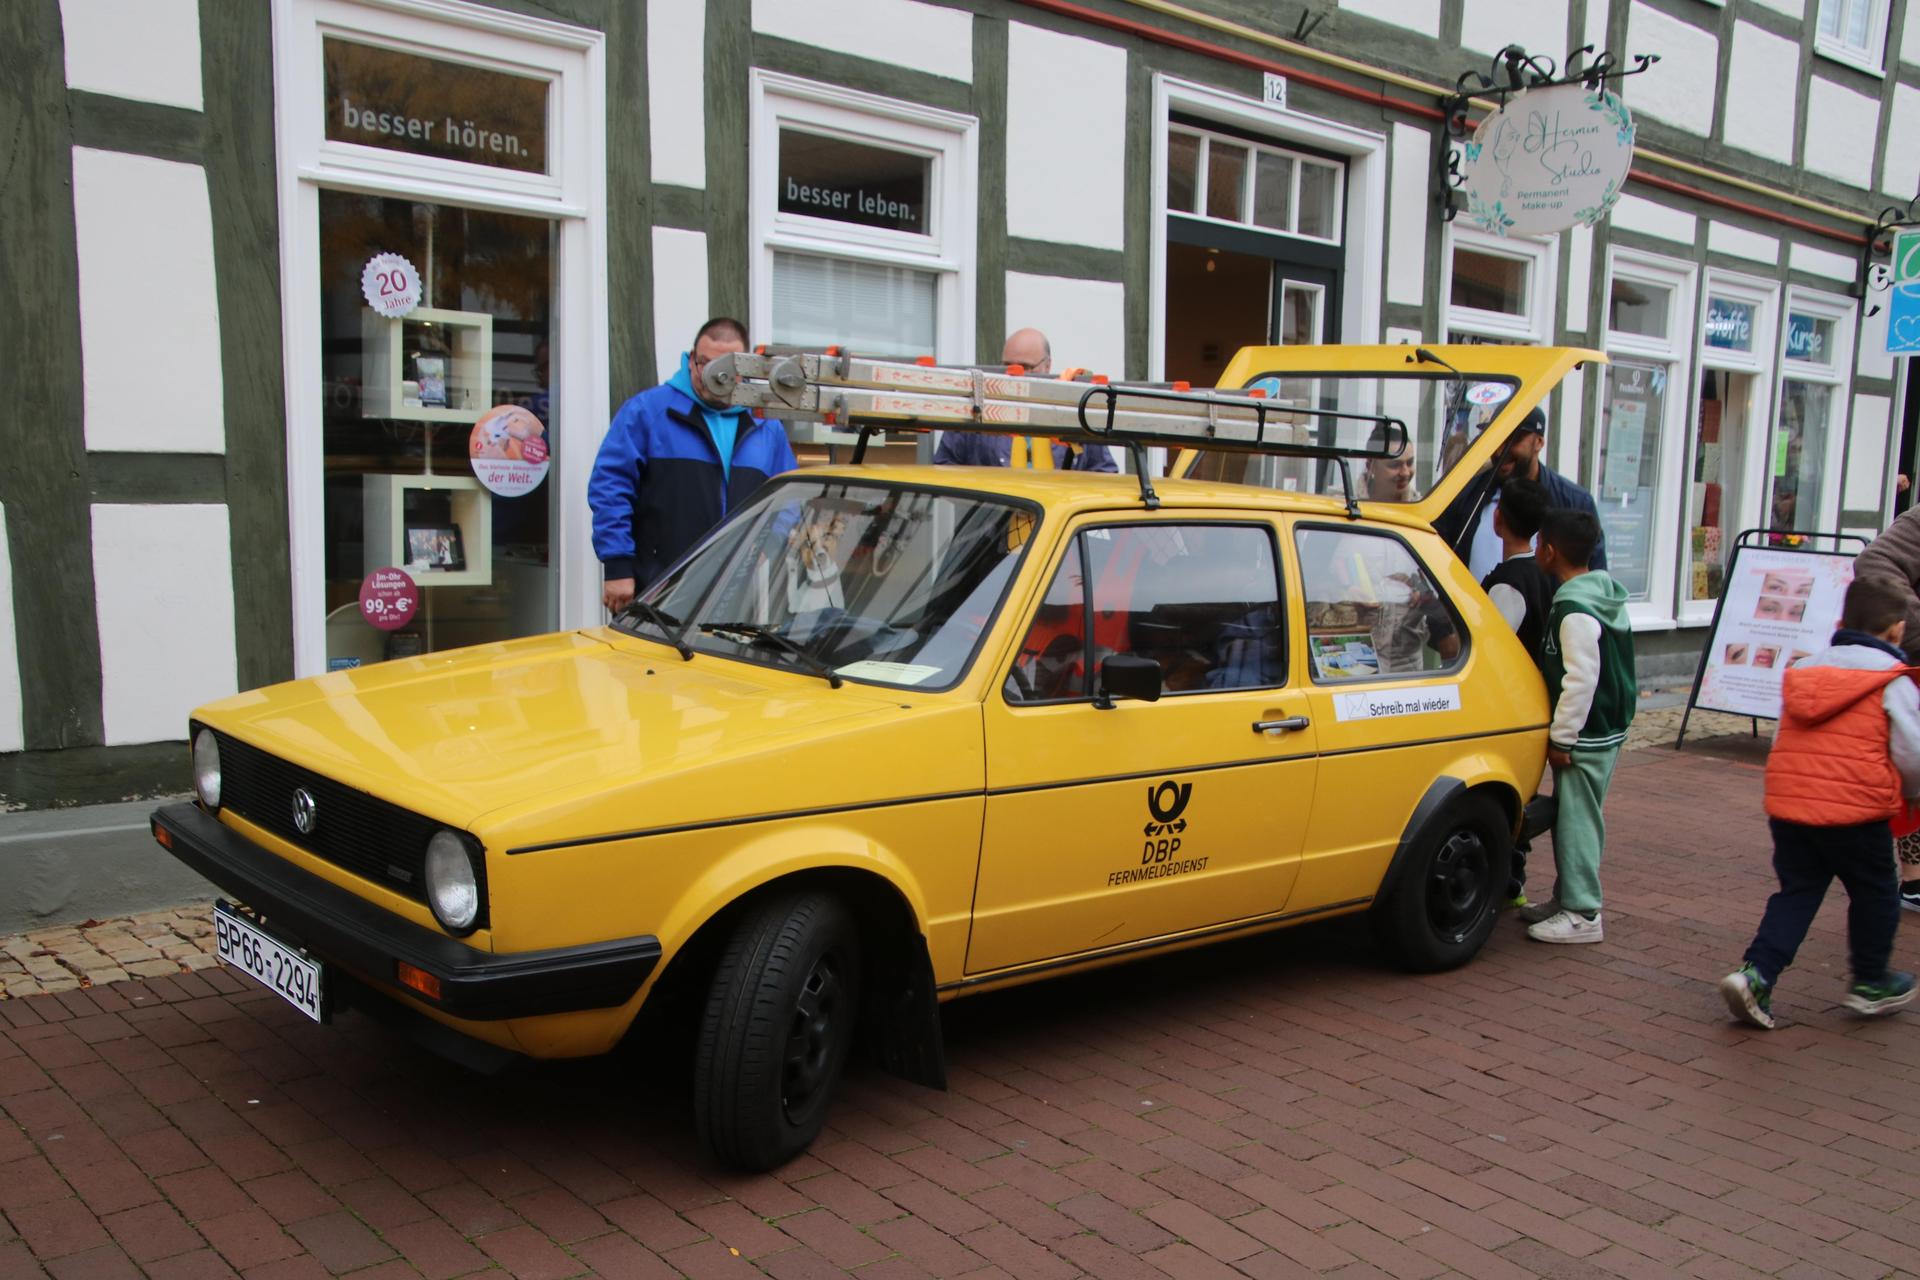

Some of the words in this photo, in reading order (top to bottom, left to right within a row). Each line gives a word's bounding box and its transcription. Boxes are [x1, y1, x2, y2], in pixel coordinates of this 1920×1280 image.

[1269, 80, 1283, 101] 12
[344, 99, 434, 141] besser
[446, 118, 528, 157] hören.
[1540, 139, 1601, 186] Studio
[787, 176, 851, 209] besser
[858, 190, 916, 221] leben.
[1517, 188, 1569, 200] Permanent
[1521, 201, 1564, 210] Make-up
[375, 269, 407, 296] 20
[384, 297, 412, 309] Jahre
[1705, 309, 1749, 340] Stoffe
[1787, 321, 1823, 353] Kurse
[488, 471, 504, 483] der
[508, 472, 533, 484] Welt.
[372, 581, 406, 590] Lösungen
[376, 573, 401, 581] Im-Ohr
[365, 599, 393, 614] 99,-
[1370, 700, 1404, 717] Schreib
[1405, 699, 1421, 713] mal
[1423, 698, 1450, 711] wieder
[1141, 838, 1182, 865] DBP
[1107, 857, 1209, 887] FERNMELDEDIENST
